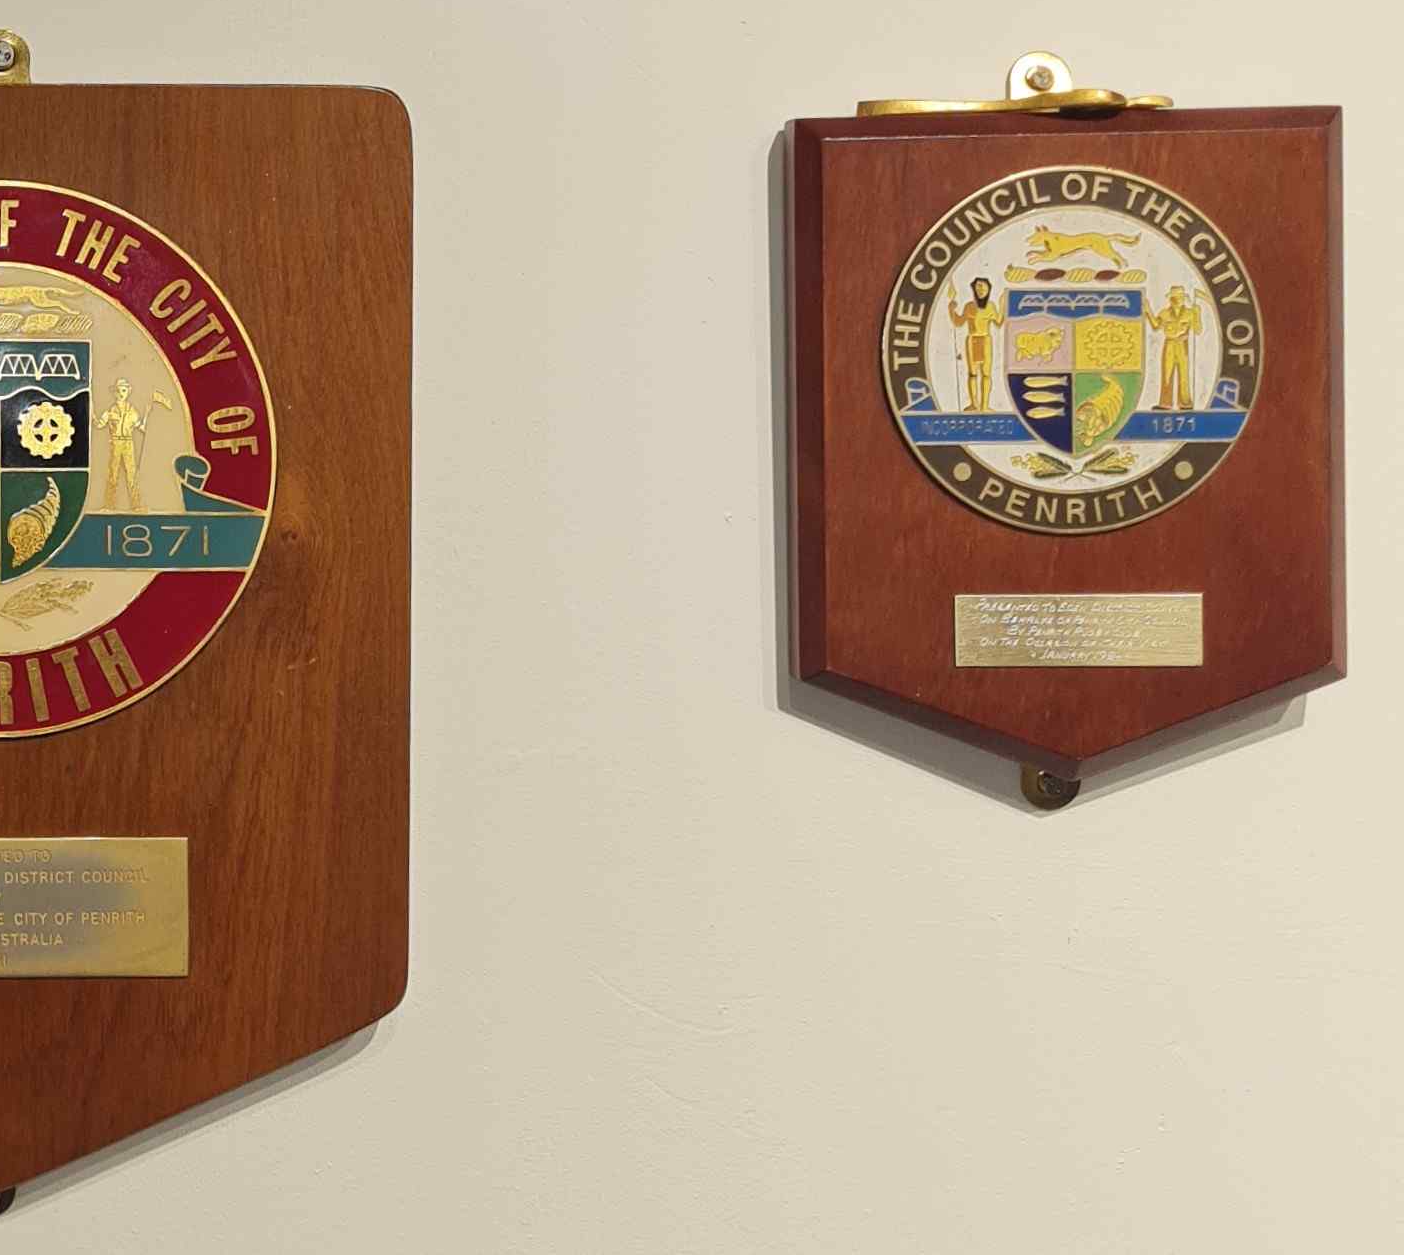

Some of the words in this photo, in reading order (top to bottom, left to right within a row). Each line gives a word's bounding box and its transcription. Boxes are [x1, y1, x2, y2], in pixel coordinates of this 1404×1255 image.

[893, 303, 926, 371] THE
[910, 177, 1051, 291] COUNCIL
[1061, 172, 1113, 202] OF
[1124, 181, 1194, 240] THE
[1188, 230, 1250, 307] CITY
[1226, 319, 1256, 370] OF
[55, 209, 141, 284] THE
[149, 278, 238, 370] CITY
[206, 406, 259, 456] OF
[1151, 416, 1196, 434] 1871
[978, 478, 1165, 525] PENRITH
[105, 525, 211, 558] 1871
[4, 871, 74, 884] DISTRICT
[81, 868, 149, 884] COUNCIL
[13, 912, 47, 926] CITY
[54, 912, 74, 926] OF
[81, 911, 145, 925] PENRITH
